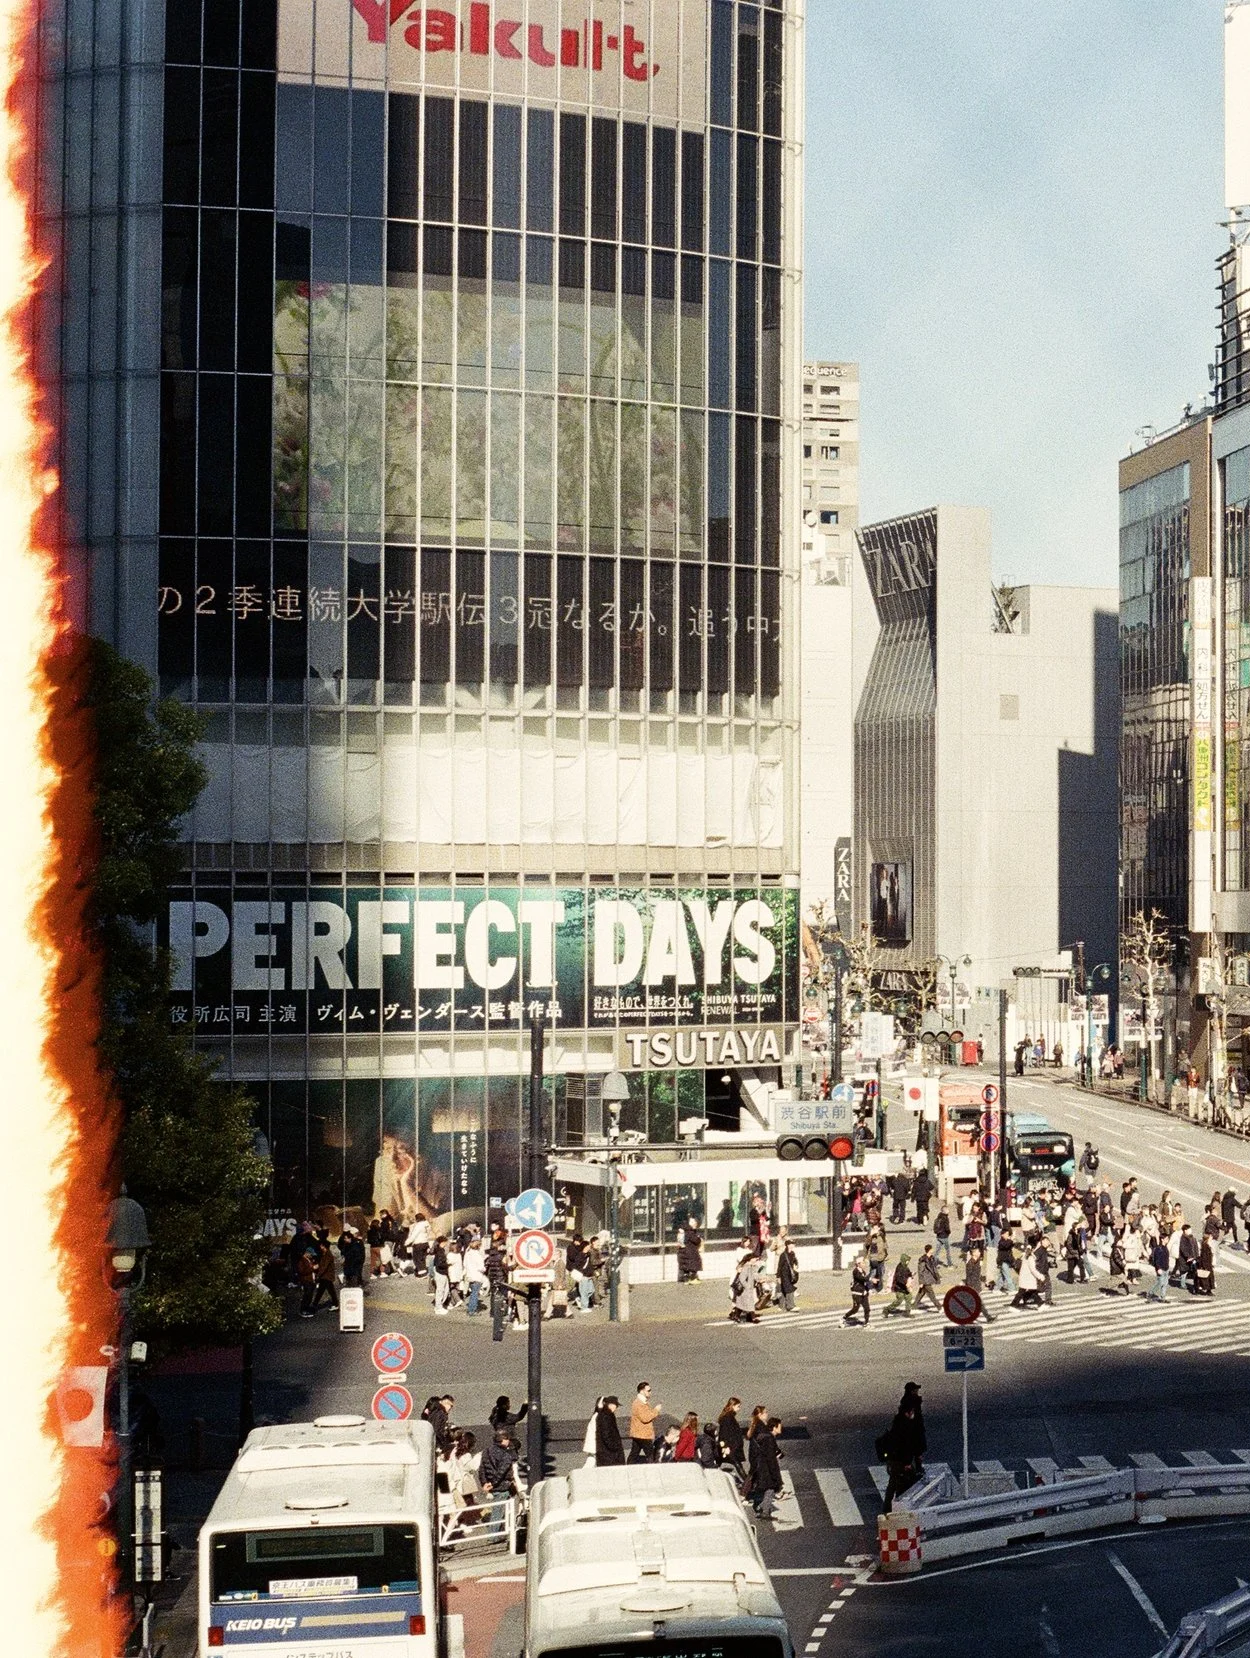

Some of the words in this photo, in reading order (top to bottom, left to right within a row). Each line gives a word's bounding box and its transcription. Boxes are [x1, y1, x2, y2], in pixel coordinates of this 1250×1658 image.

[351, 0, 660, 82] Yakult
[803, 365, 848, 377] equence
[836, 847, 850, 901] ZARA
[168, 900, 565, 991] PERFECT
[594, 900, 776, 985] DAYS
[170, 1005, 251, 1023] 役所広司
[258, 1005, 298, 1022] 主演
[317, 1001, 562, 1022] ヴィム・ヴェンダース監督作品
[626, 1030, 781, 1067] TSUTAYA
[781, 1105, 846, 1120] 渋谷駅前
[790, 1122, 821, 1132] Shibuya
[225, 1619, 262, 1632] KEIO
[262, 1617, 297, 1635] BUS
